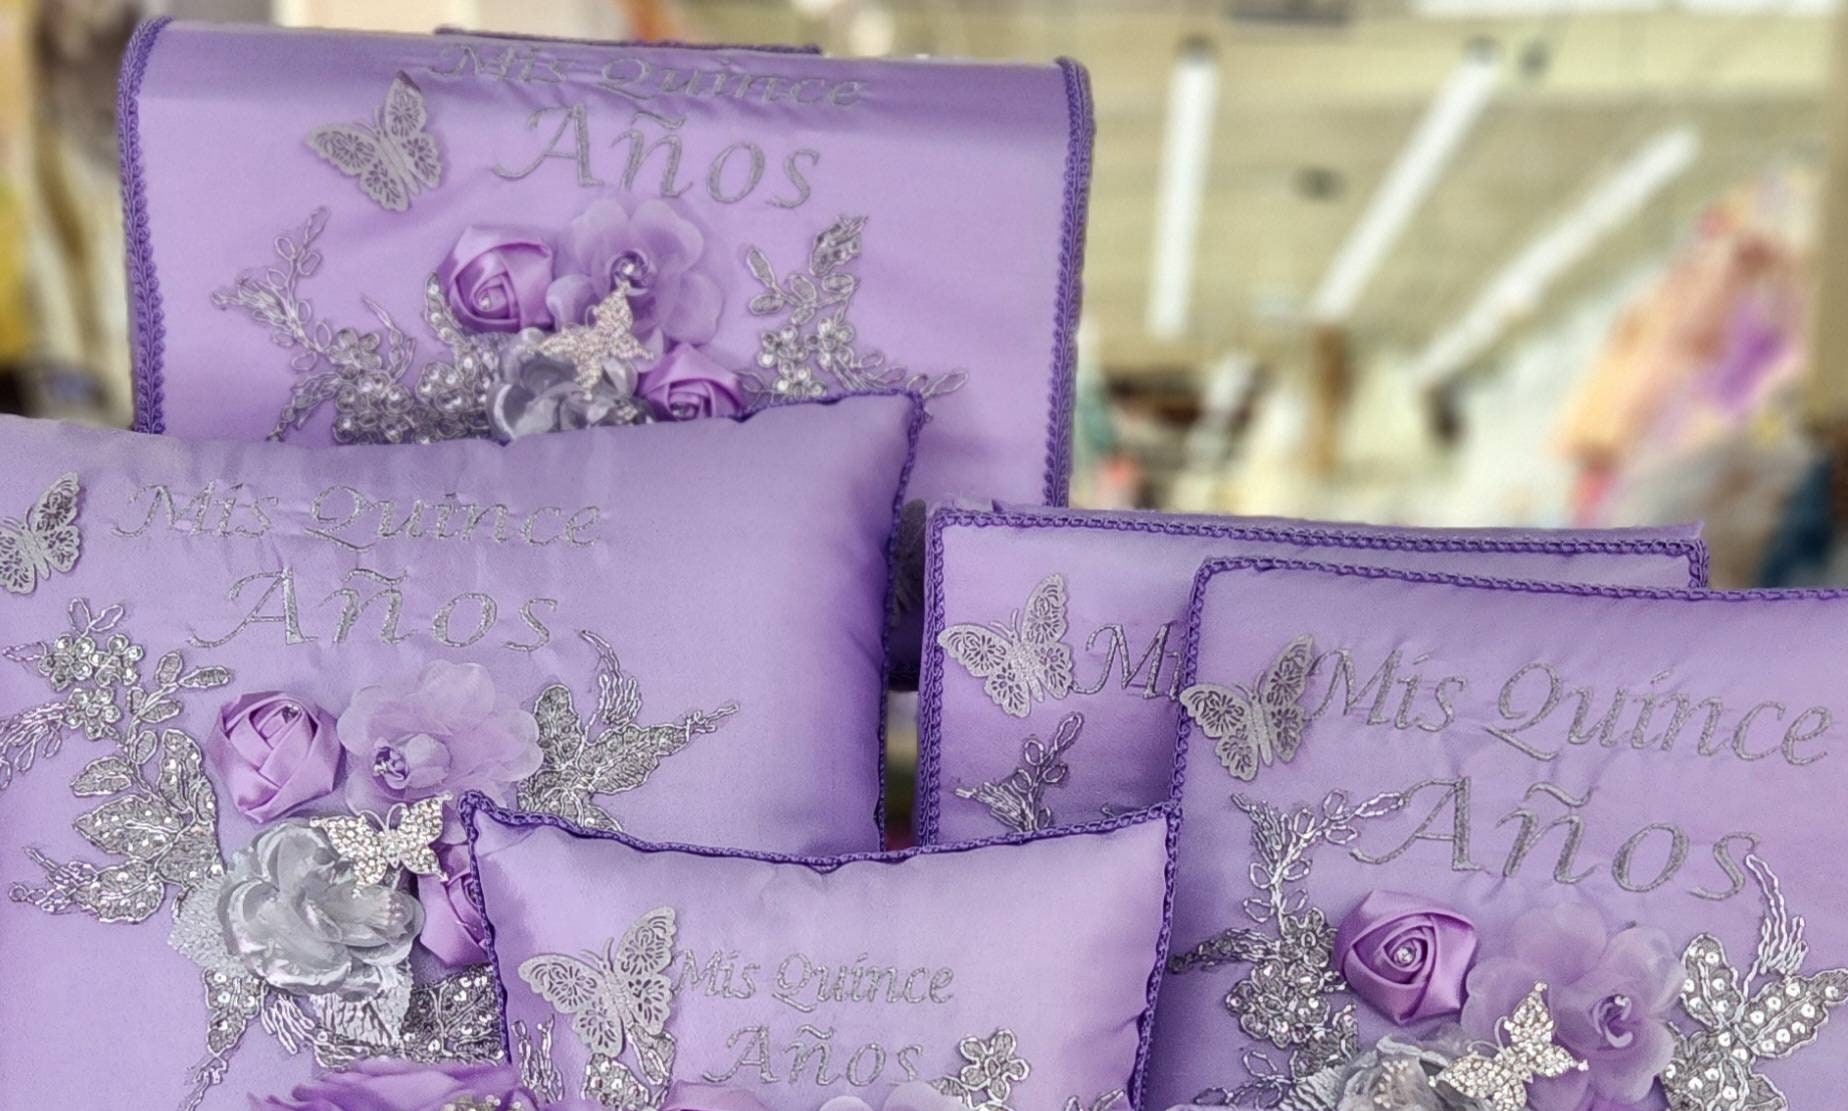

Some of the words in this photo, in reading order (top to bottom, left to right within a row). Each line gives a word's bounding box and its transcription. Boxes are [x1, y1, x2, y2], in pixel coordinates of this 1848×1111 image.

[491, 102, 820, 209] Años
[112, 482, 279, 538] Mis
[304, 485, 601, 552] Quince
[186, 566, 559, 652] Años
[1070, 621, 1182, 702] Mi
[1305, 647, 1468, 732] Mis
[1348, 774, 1761, 901] Años
[672, 949, 761, 1000] Mis
[701, 1024, 924, 1087] Años
